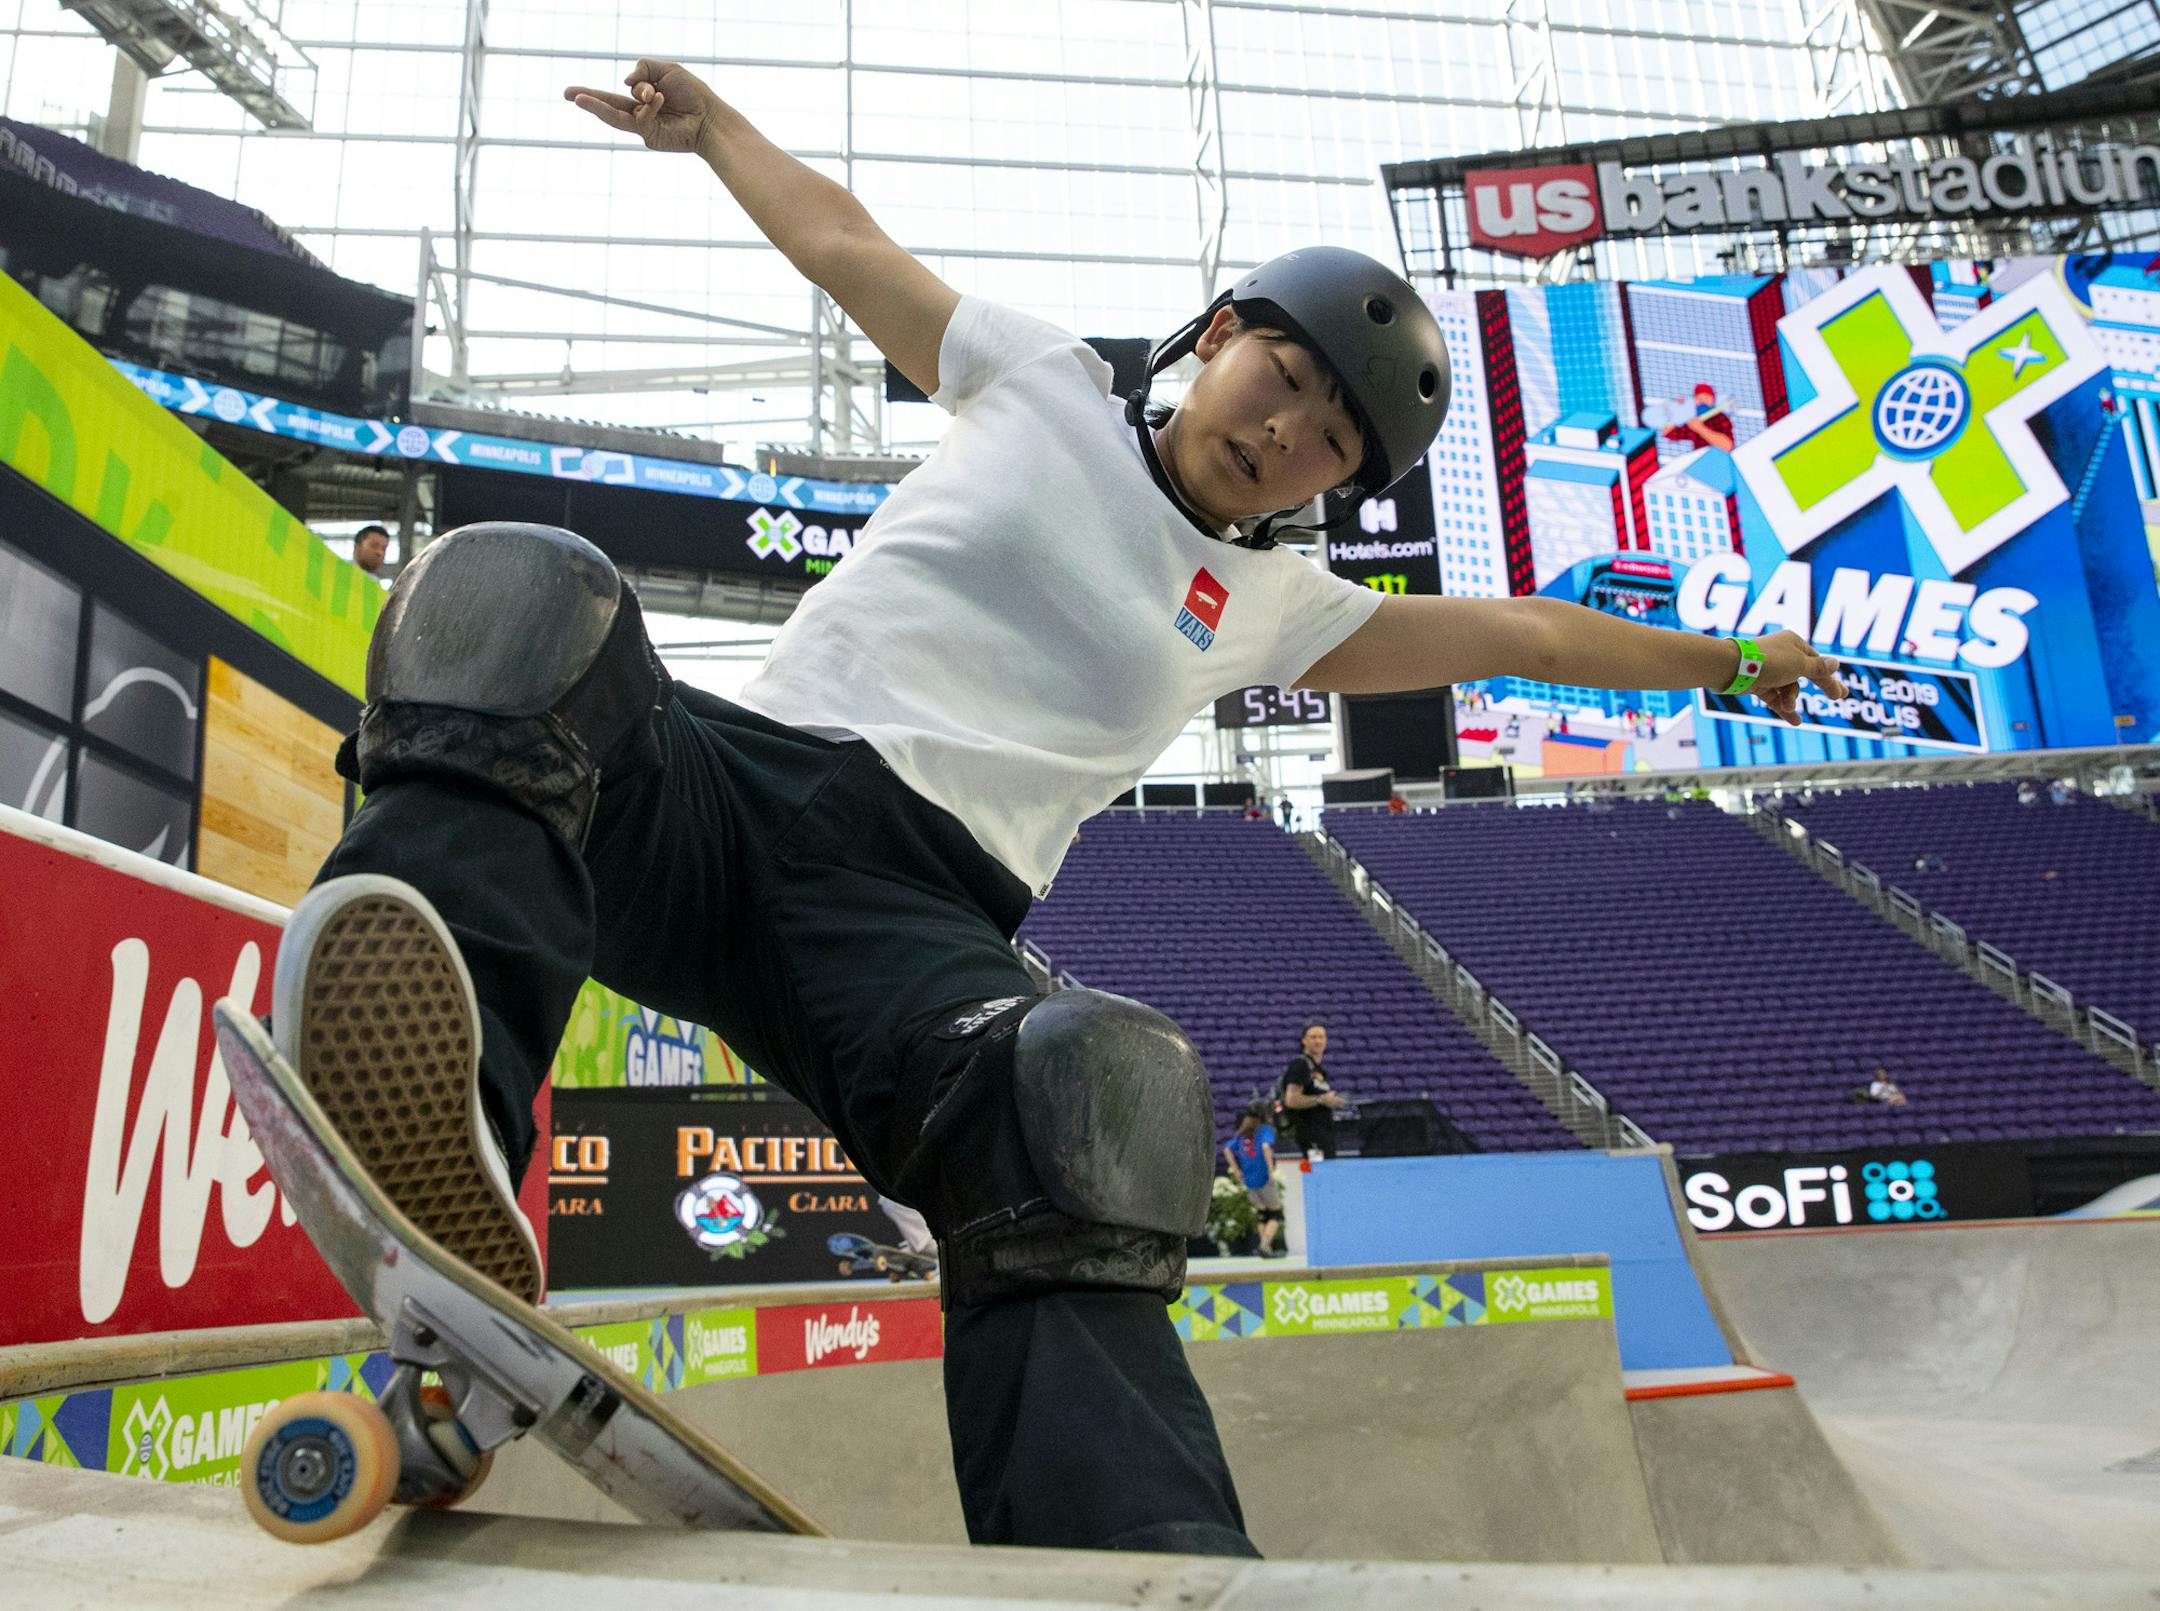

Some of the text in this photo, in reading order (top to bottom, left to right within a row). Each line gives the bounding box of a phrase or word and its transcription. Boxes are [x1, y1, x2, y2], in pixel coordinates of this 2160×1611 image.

[1475, 177, 1597, 237] us
[469, 442, 542, 466] MINNEAPOLIS
[645, 467, 713, 488] MINNEAPOLIS
[1676, 552, 2039, 668] GAMES
[1174, 606, 1215, 652] VANS
[1244, 687, 1326, 723] 5:45
[1879, 677, 1940, 707] 2019
[788, 1191, 869, 1213] CLARA
[1685, 1165, 1853, 1231] SoFi
[1310, 1291, 1389, 1315] GAMES
[1527, 1279, 1599, 1304] GAMES
[703, 1326, 748, 1358] GAMES
[805, 1305, 880, 1365] Wendy's
